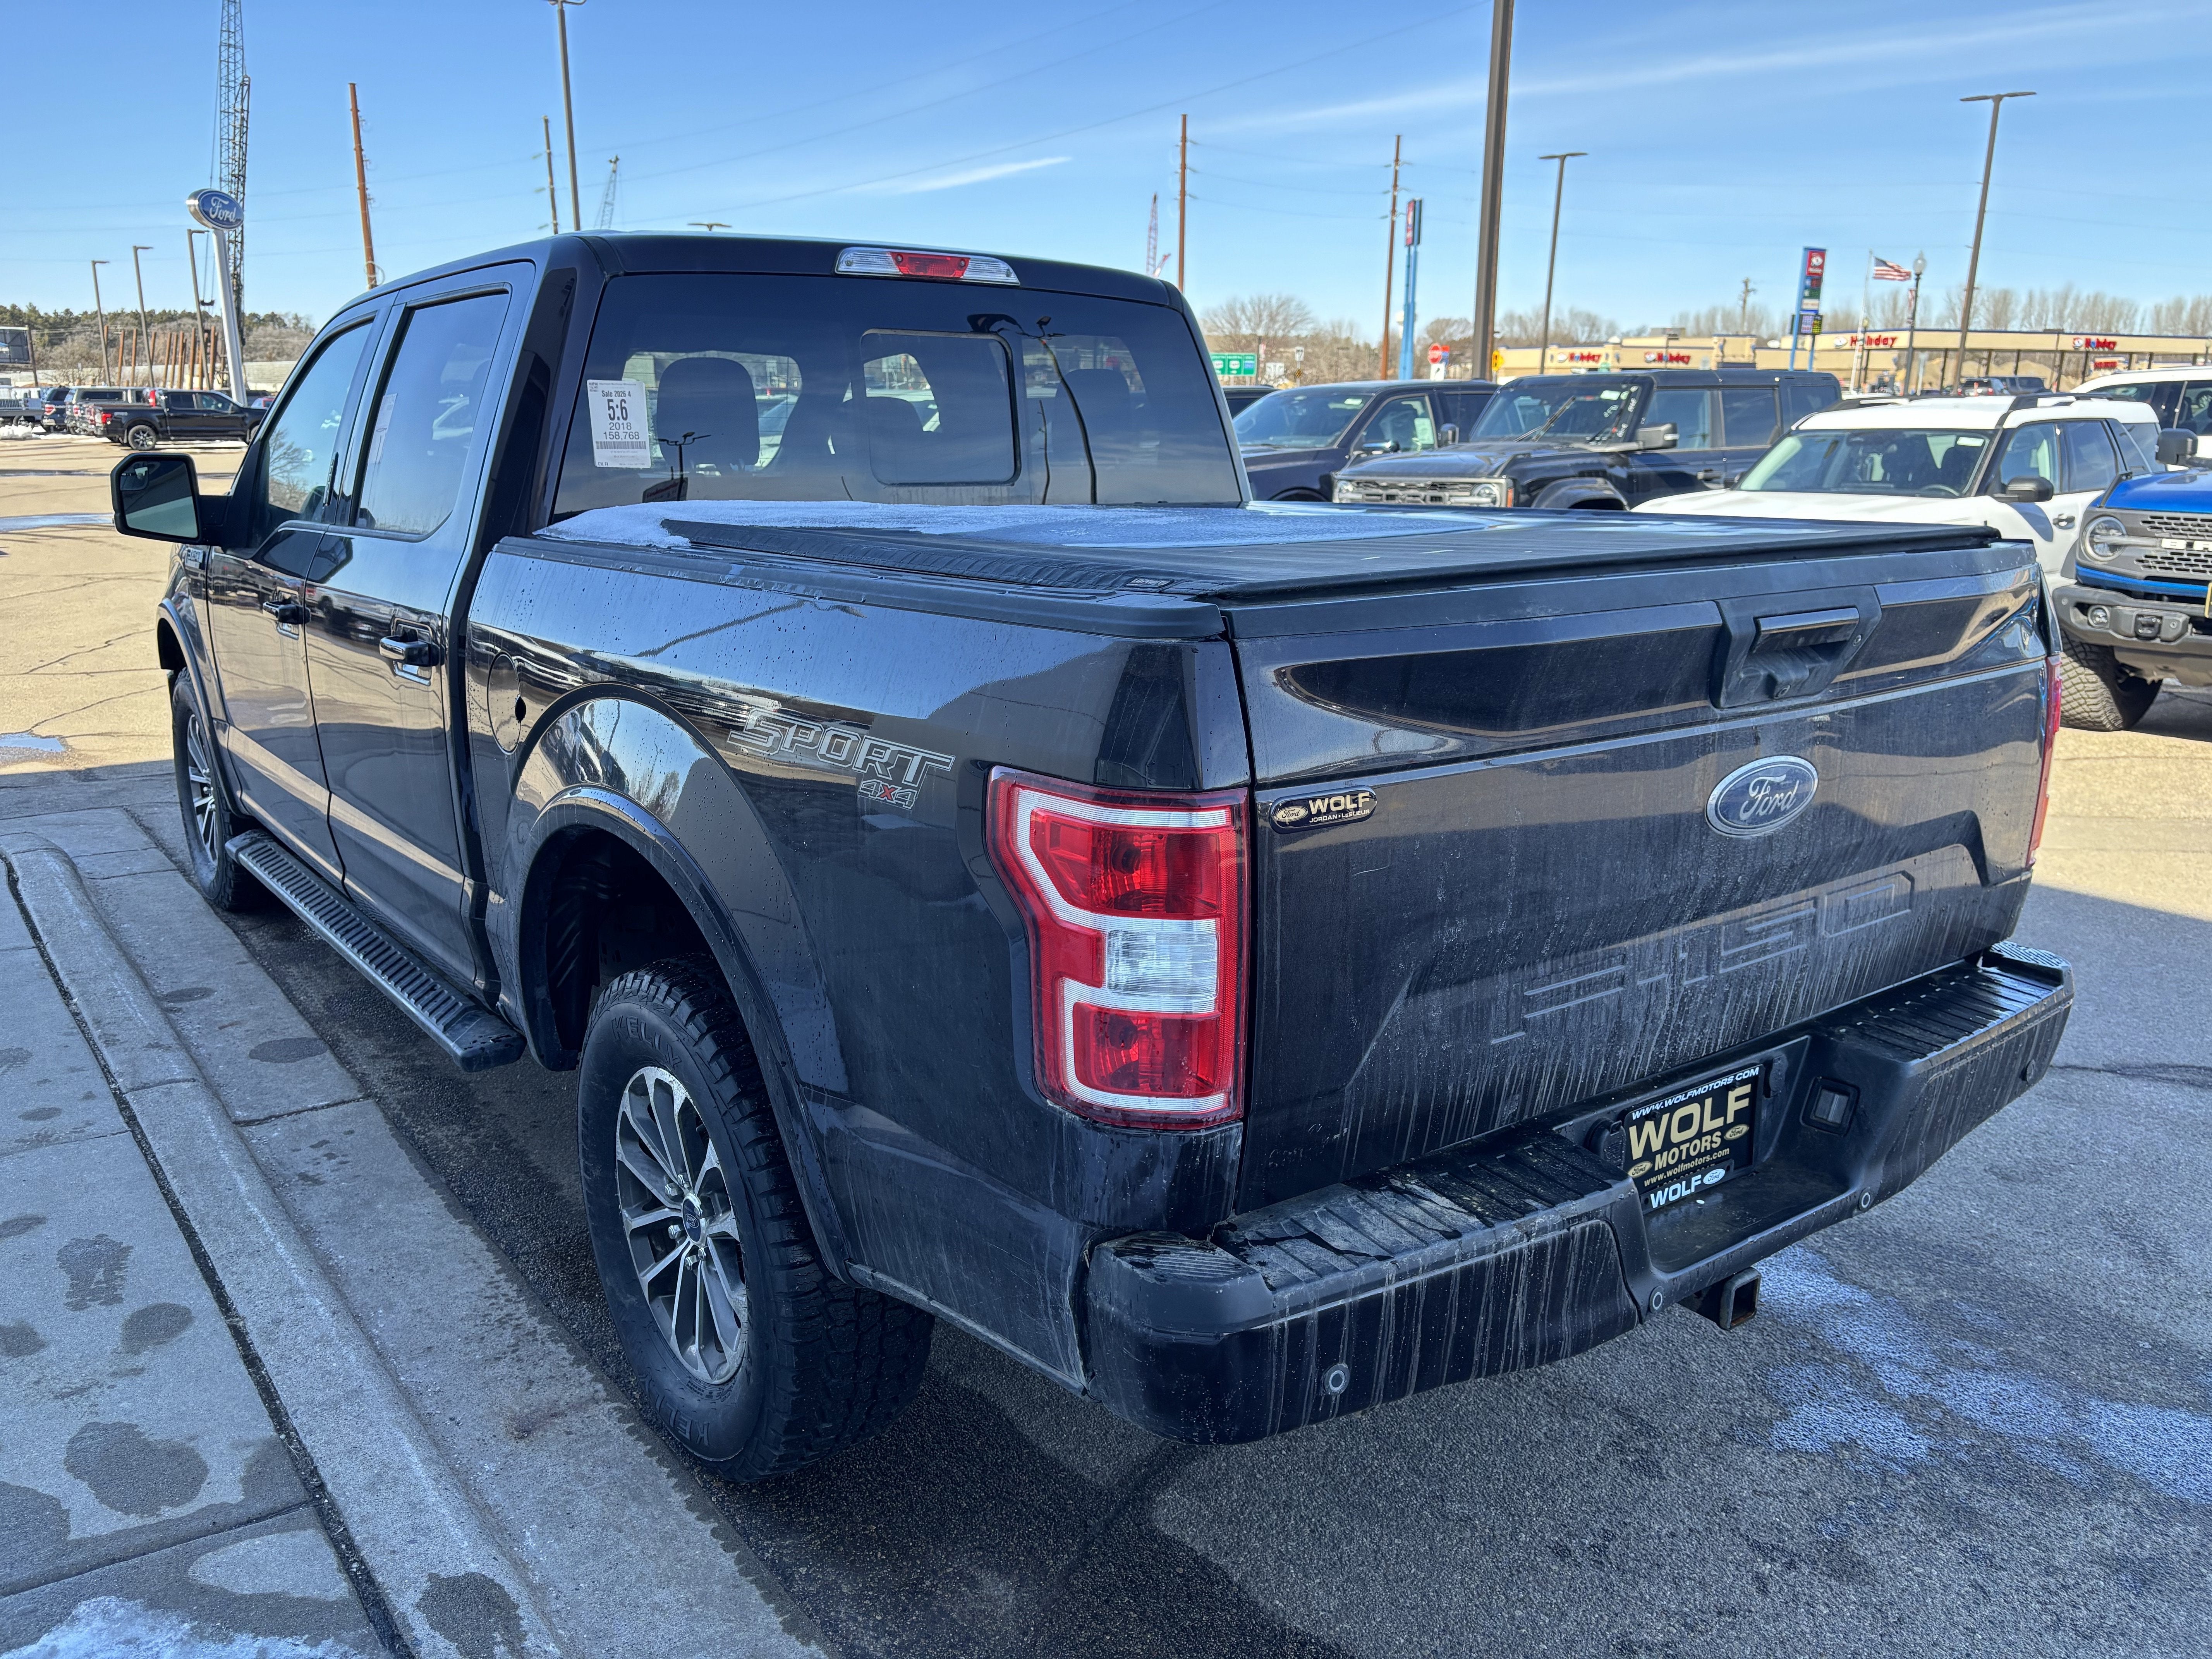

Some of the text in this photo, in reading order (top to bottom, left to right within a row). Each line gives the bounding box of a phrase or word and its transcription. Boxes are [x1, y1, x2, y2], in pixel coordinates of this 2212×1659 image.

[209, 196, 236, 222] Ford
[1850, 335, 1898, 348] Hliday
[607, 399, 628, 421] 5:6
[603, 431, 640, 440] 158,768
[609, 422, 632, 430] 2018
[726, 708, 957, 787] SPORT
[1309, 792, 1370, 814] WOLF
[1739, 775, 1799, 821] Ford
[1309, 814, 1338, 823] JORDAN
[1632, 1067, 1759, 1120] WWW.WOLFMOTORSCOM
[1629, 1084, 1752, 1160] WOLF
[1654, 1131, 1722, 1171] MOTORS
[1644, 1147, 1730, 1187] www.wolfmotors.com
[1650, 1175, 1702, 1209] WOLF
